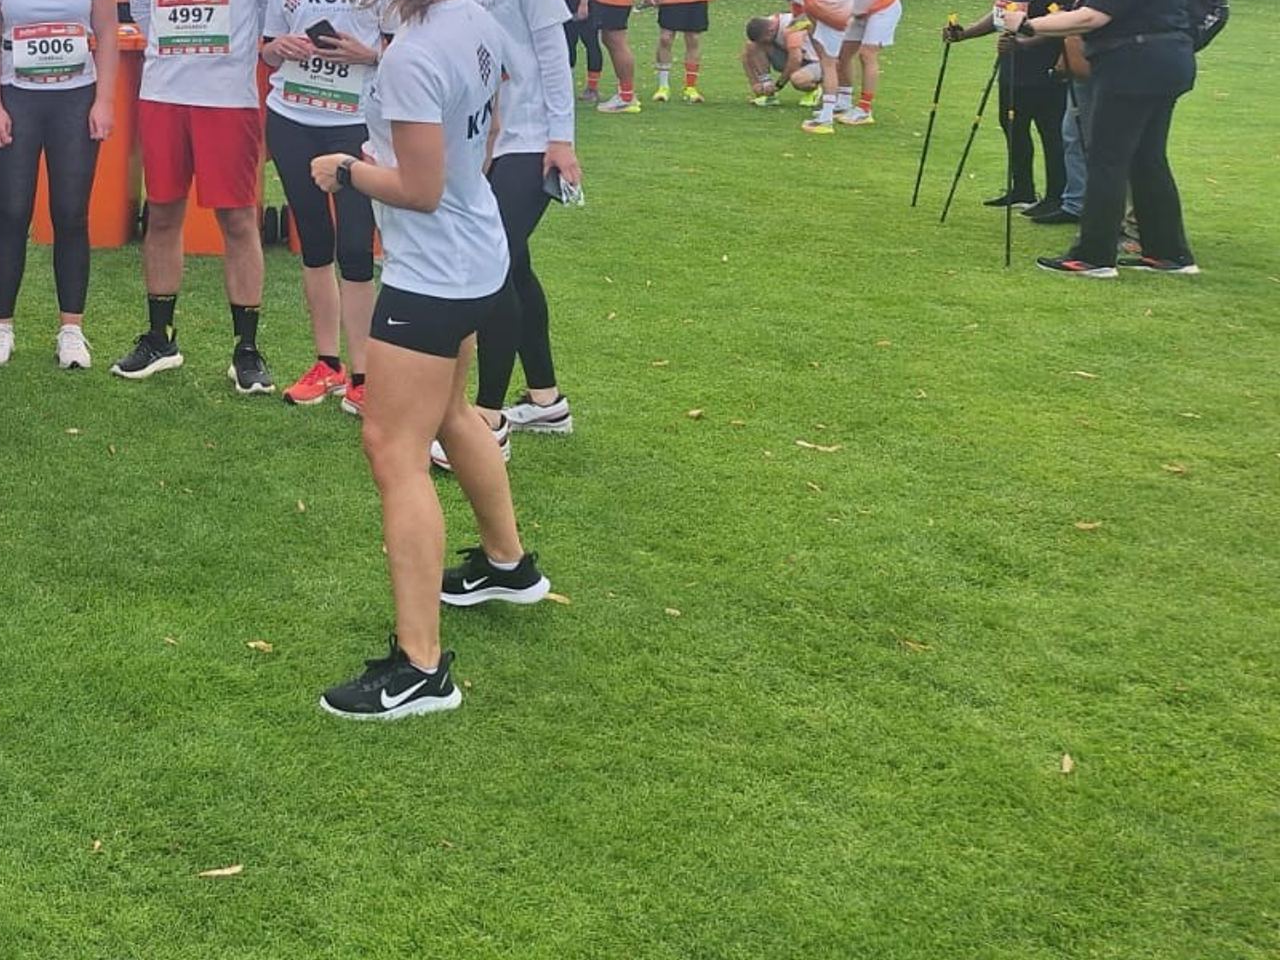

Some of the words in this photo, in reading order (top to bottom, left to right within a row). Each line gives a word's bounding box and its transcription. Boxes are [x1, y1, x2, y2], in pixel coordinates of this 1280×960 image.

[168, 7, 215, 23] 4997
[27, 39, 74, 55] 5006
[299, 57, 349, 78] 4998
